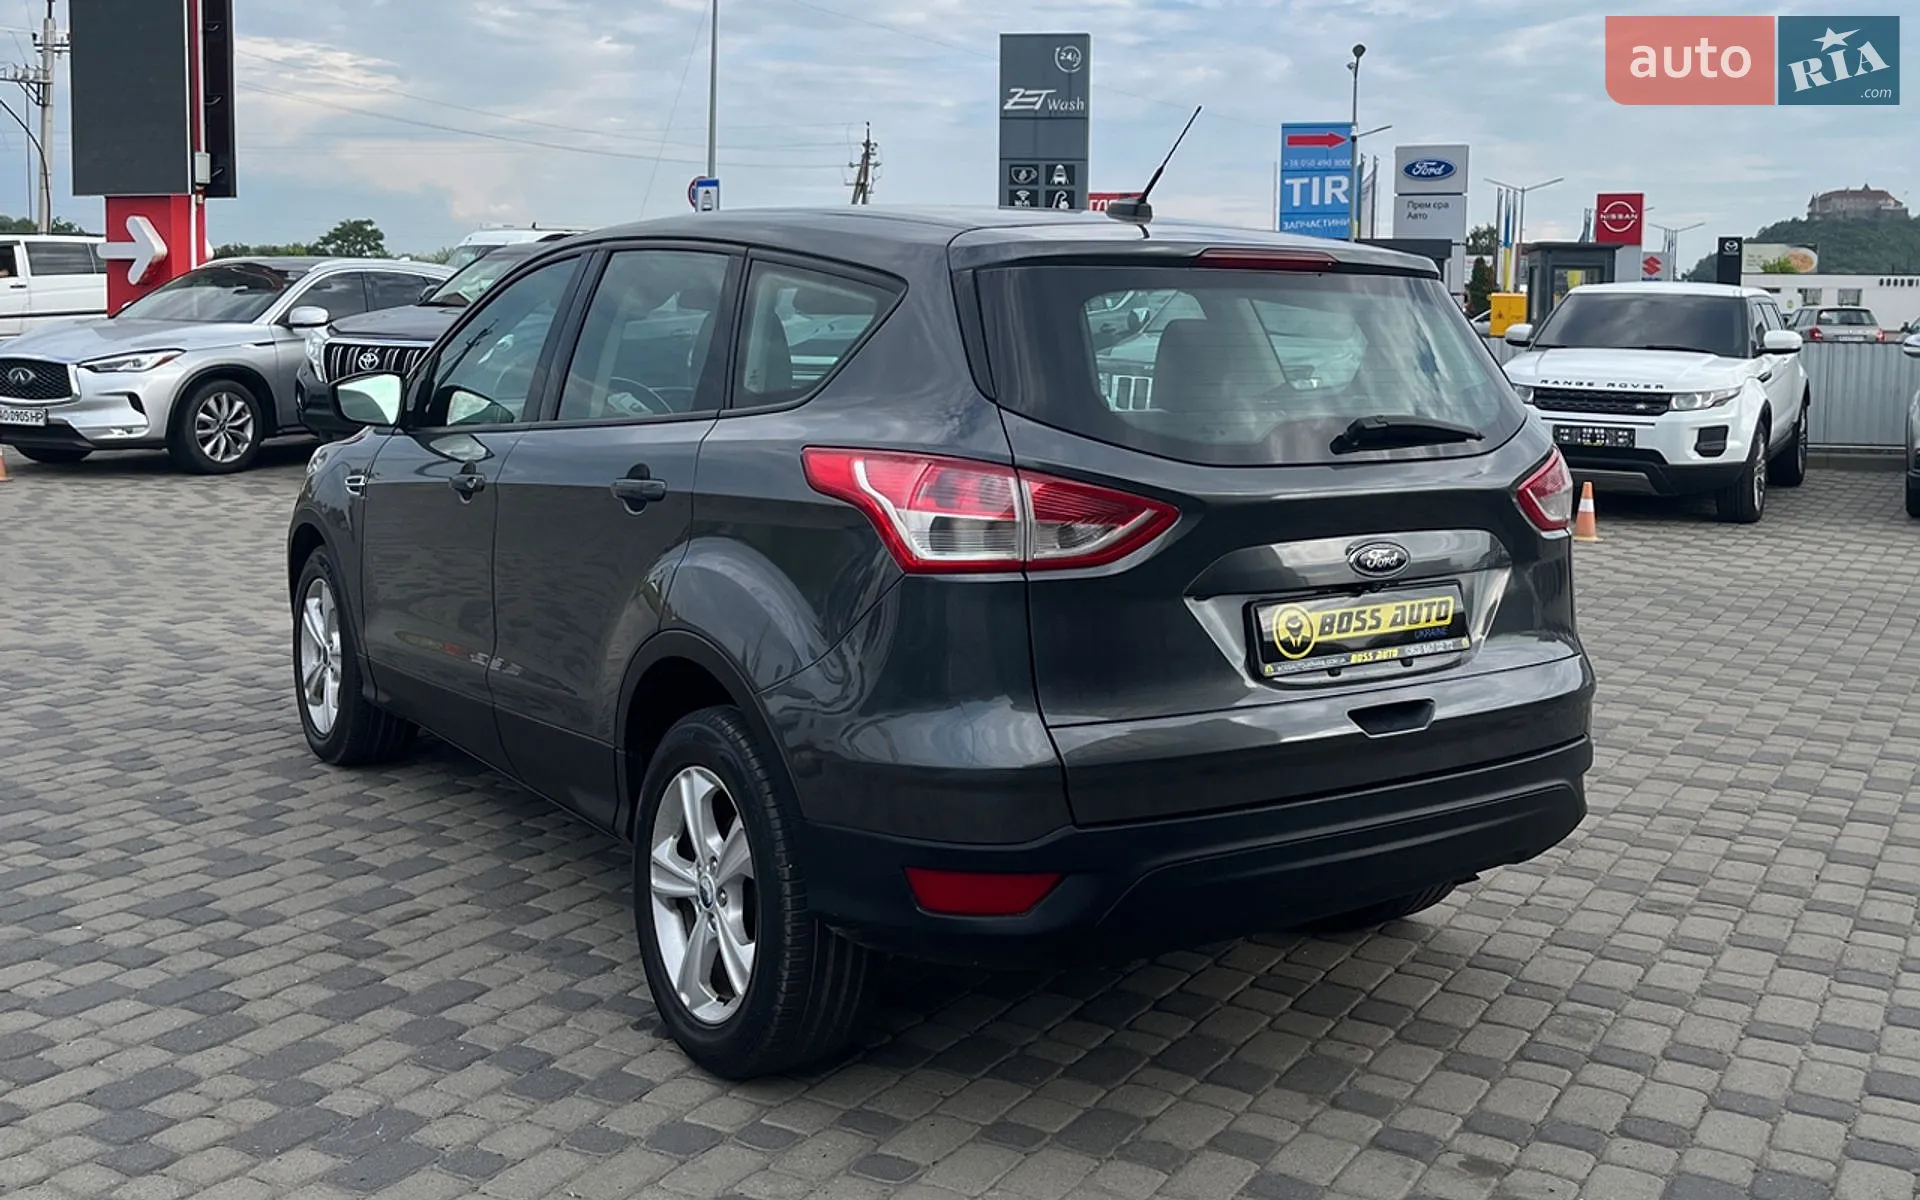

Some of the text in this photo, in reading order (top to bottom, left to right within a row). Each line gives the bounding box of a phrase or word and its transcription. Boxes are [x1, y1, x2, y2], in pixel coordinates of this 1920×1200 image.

[1003, 88, 1085, 112] ZET Wash
[1411, 161, 1446, 176] Ford
[1284, 175, 1350, 207] TIR
[1406, 211, 1428, 220] Авто
[1600, 213, 1638, 221] NISSAN
[1540, 379, 1664, 390] RANGE ROVER
[1366, 549, 1399, 568] Ford
[1319, 601, 1450, 636] BOSS AUTO
[1350, 652, 1374, 664] BOSS
[1376, 648, 1399, 659] AUTO
